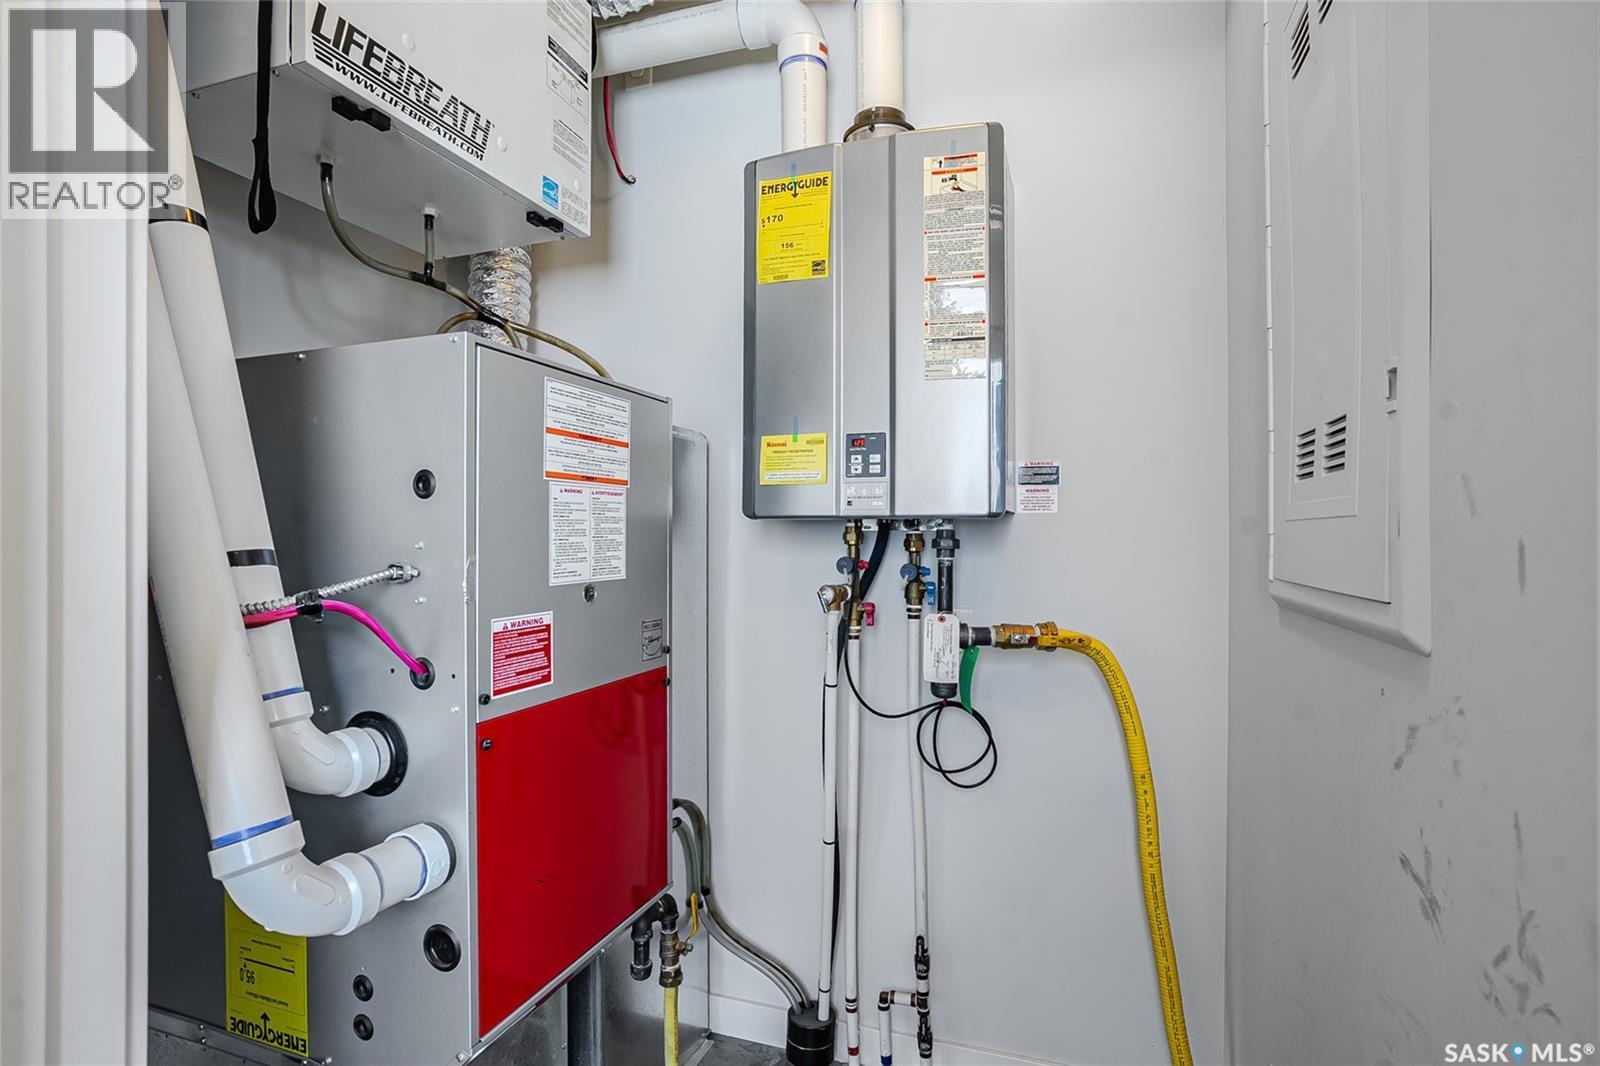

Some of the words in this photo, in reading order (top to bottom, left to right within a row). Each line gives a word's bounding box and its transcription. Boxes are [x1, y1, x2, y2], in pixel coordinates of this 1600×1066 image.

[311, 1, 492, 147] LIFEBREATH
[334, 61, 484, 162] WWW.LIFEBREATH.COM
[761, 176, 829, 196] ENERGYGUIDE
[510, 617, 544, 629] WARNING
[229, 1016, 307, 1054] ENERGYGUIDE
